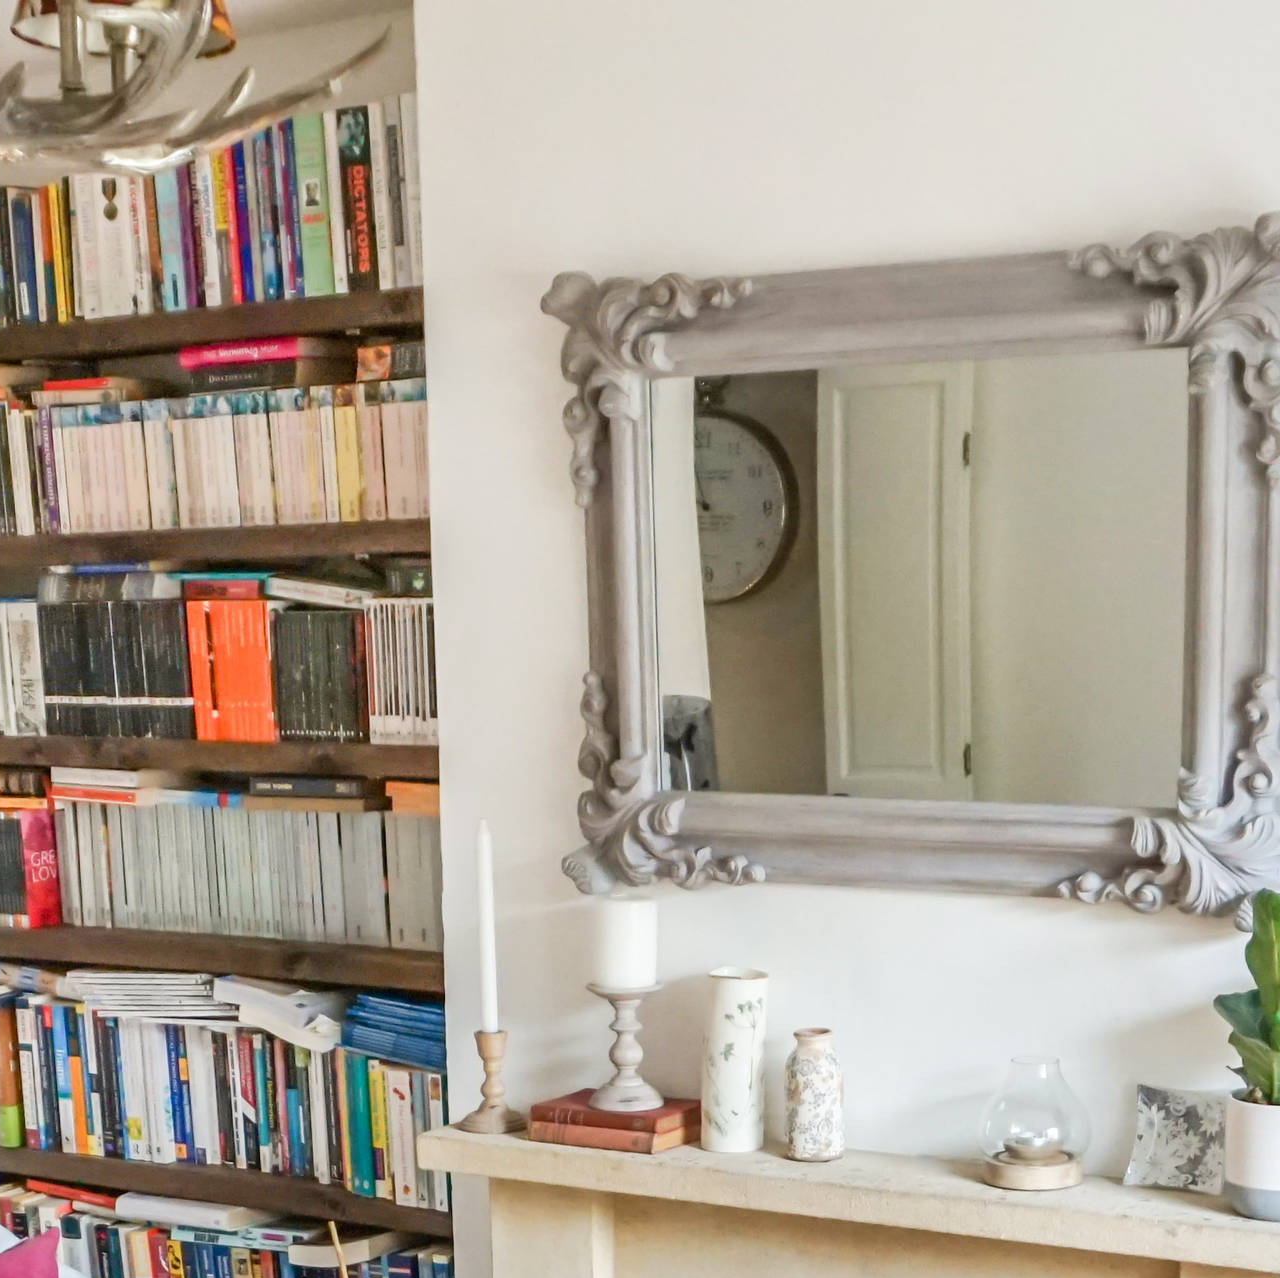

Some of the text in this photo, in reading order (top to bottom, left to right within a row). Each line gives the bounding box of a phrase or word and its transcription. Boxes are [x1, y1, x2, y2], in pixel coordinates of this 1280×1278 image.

[352, 165, 370, 273] DICTATORS
[31, 850, 56, 866] GRE
[32, 866, 58, 883] LOV
[55, 1049, 66, 1086] Trauma
